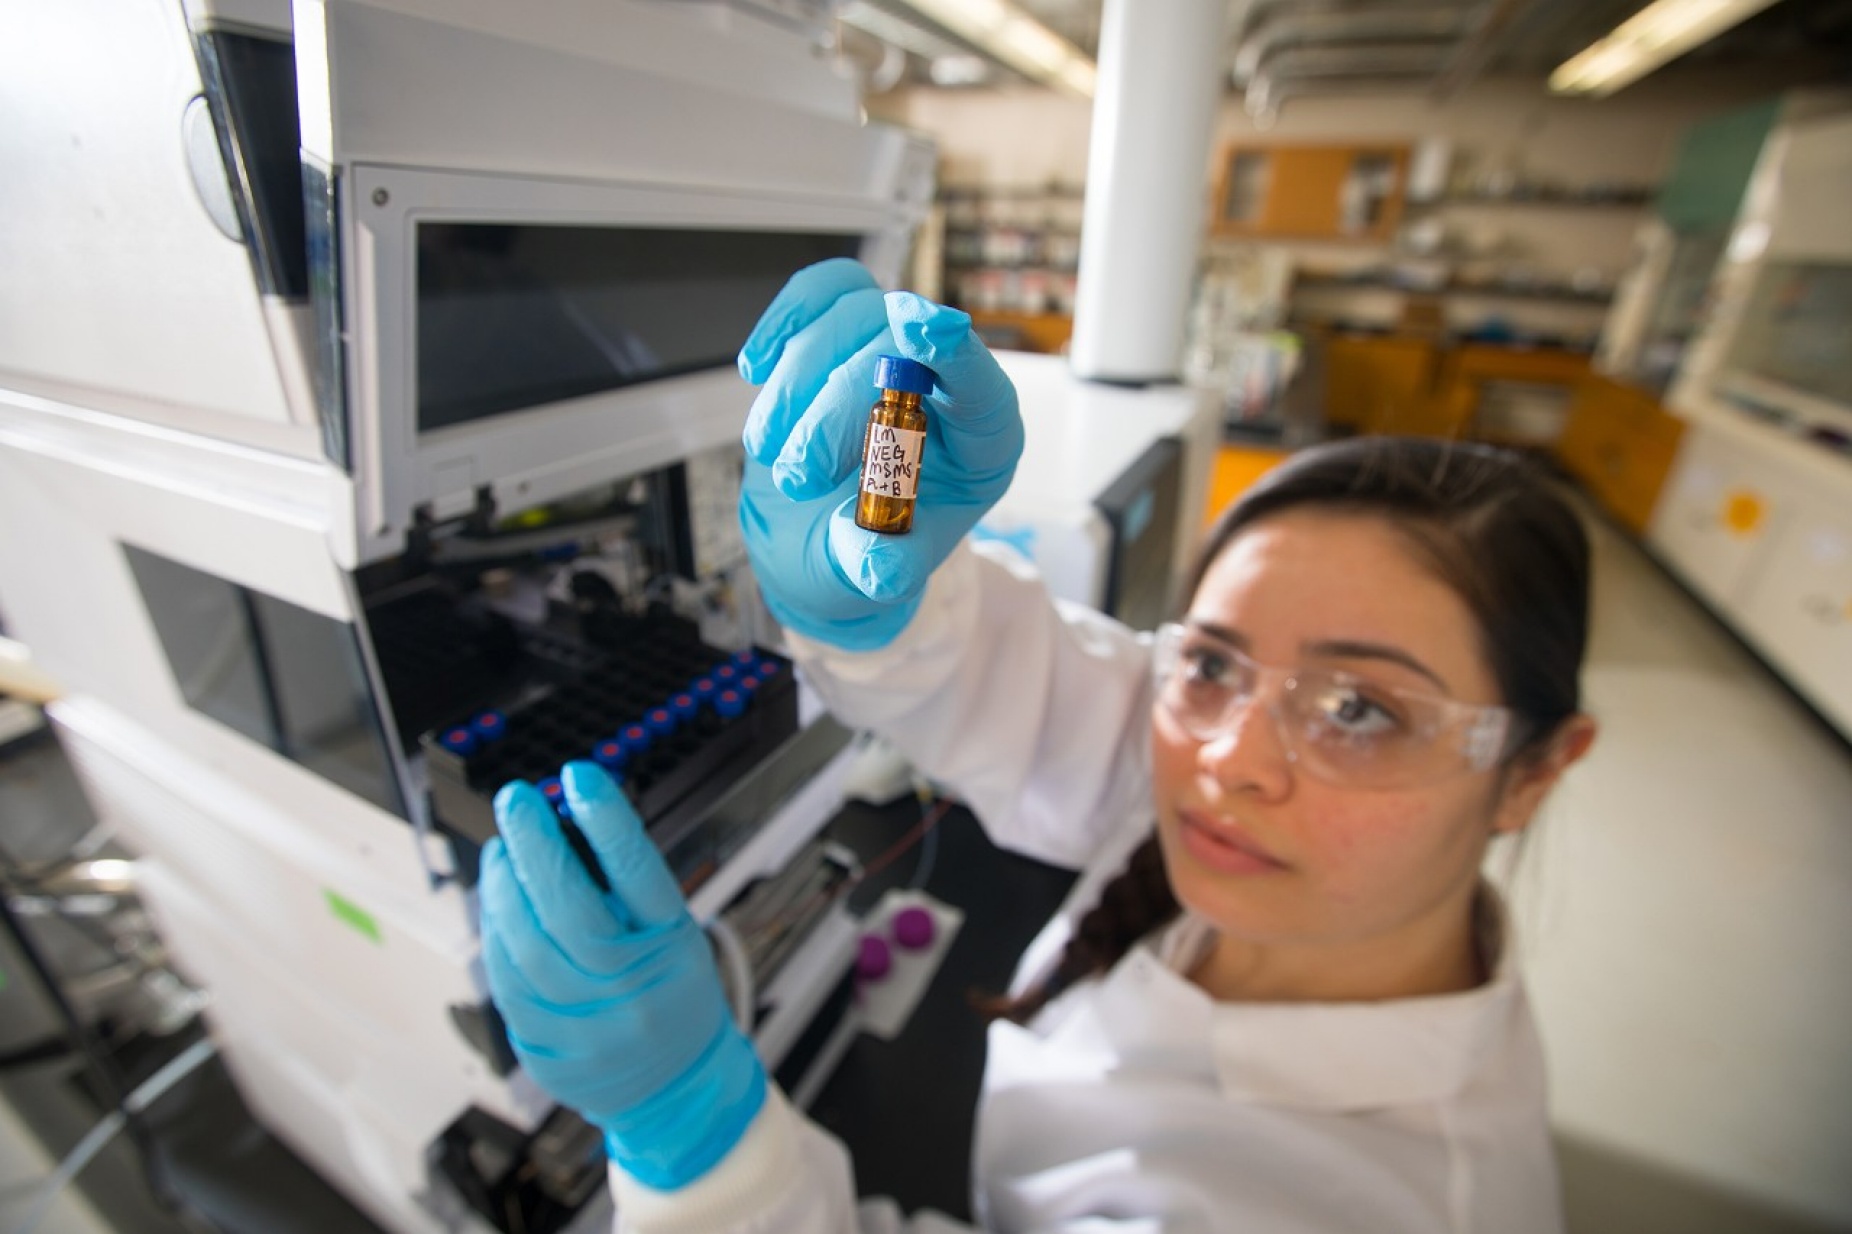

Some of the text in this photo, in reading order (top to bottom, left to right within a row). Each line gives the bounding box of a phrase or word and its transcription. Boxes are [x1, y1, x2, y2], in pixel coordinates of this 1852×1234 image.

[874, 427, 896, 443] LM
[871, 445, 905, 462] NEG
[869, 461, 912, 479] MSMS
